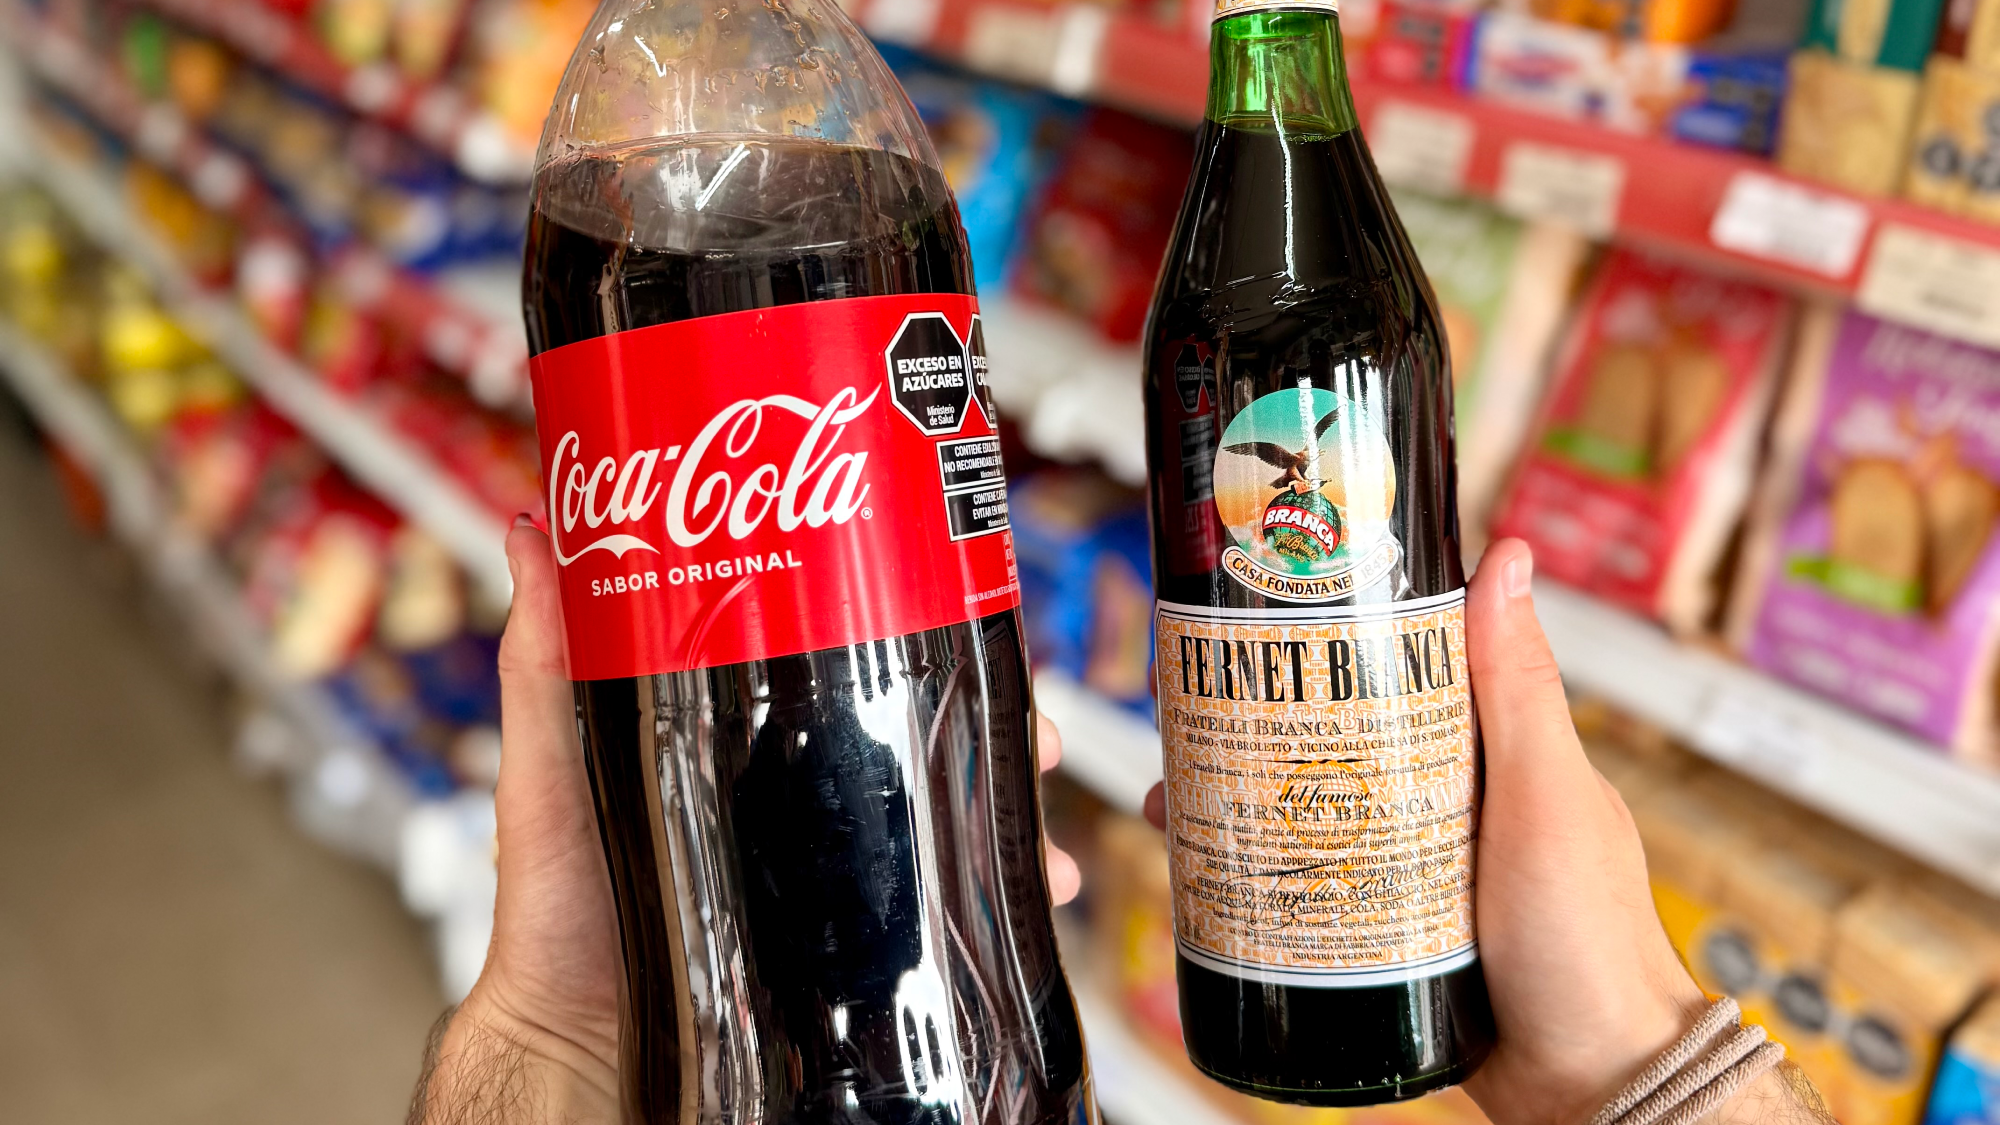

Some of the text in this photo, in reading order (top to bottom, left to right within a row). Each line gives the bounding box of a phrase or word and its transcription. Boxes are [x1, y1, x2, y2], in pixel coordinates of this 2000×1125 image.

[897, 355, 963, 374] EXCESO EN
[971, 355, 988, 369] EXCES
[902, 372, 964, 393] AZÚCARES
[926, 404, 956, 417] Ministerio
[929, 414, 955, 426] de Salud
[954, 444, 983, 457] CONTIENE
[550, 382, 883, 566] Coca-Cola
[943, 461, 956, 473] NO
[1264, 508, 1334, 552] BRANCA
[591, 550, 803, 597] SABOR ORIGINAL
[1232, 557, 1263, 585] CASA
[1266, 576, 1328, 595] FONDATA
[1361, 553, 1388, 581] 1845
[1178, 627, 1455, 702] FERNET BRANCA
[1174, 708, 1250, 735] FRATELLI
[1251, 718, 1343, 737] BRANCA
[1185, 731, 1214, 747] MILANO
[1219, 739, 1236, 750] VIA
[1236, 741, 1291, 753] BROLETTO
[1299, 742, 1339, 753] VICINO
[1341, 740, 1369, 752] ALLA
[1409, 734, 1421, 745] DI
[1422, 733, 1430, 743] S.
[1430, 724, 1459, 741] TOMASO
[1215, 766, 1245, 777] Branca,
[1251, 769, 1267, 778] soli
[1268, 770, 1285, 780] che
[1286, 772, 1338, 782] posseggono
[1339, 768, 1384, 781] l'originale
[1417, 761, 1425, 771] di
[1277, 783, 1374, 810] del famoso
[1223, 796, 1434, 822] FERNET BRANCA
[1260, 828, 1285, 837] grazie
[1286, 826, 1295, 836] al
[1296, 827, 1329, 841] processo
[1331, 825, 1341, 837] di
[1401, 822, 1413, 832] che
[1315, 838, 1325, 850] ed
[1326, 840, 1351, 850] esotici
[1353, 837, 1367, 849] dai
[1368, 836, 1397, 851] superbi
[1217, 850, 1267, 863] CONOSCIUTO
[1268, 856, 1280, 865] ED
[1280, 857, 1338, 868] APPREZZATO
[1338, 857, 1348, 866] IN
[1350, 855, 1379, 866] TUTTO
[1379, 854, 1388, 863] IL
[1388, 849, 1418, 862] MONDO
[1419, 847, 1434, 858] PER
[1343, 867, 1385, 879] INDICATO
[1427, 879, 1442, 891] NEL
[1349, 903, 1379, 913] COLA,
[1380, 899, 1405, 911] SODA
[1406, 899, 1414, 908] O
[1415, 892, 1439, 906] ALTRE
[1282, 941, 1309, 949] BRANCA
[1292, 950, 1383, 961] INDUSTRIA ARGENTINA
